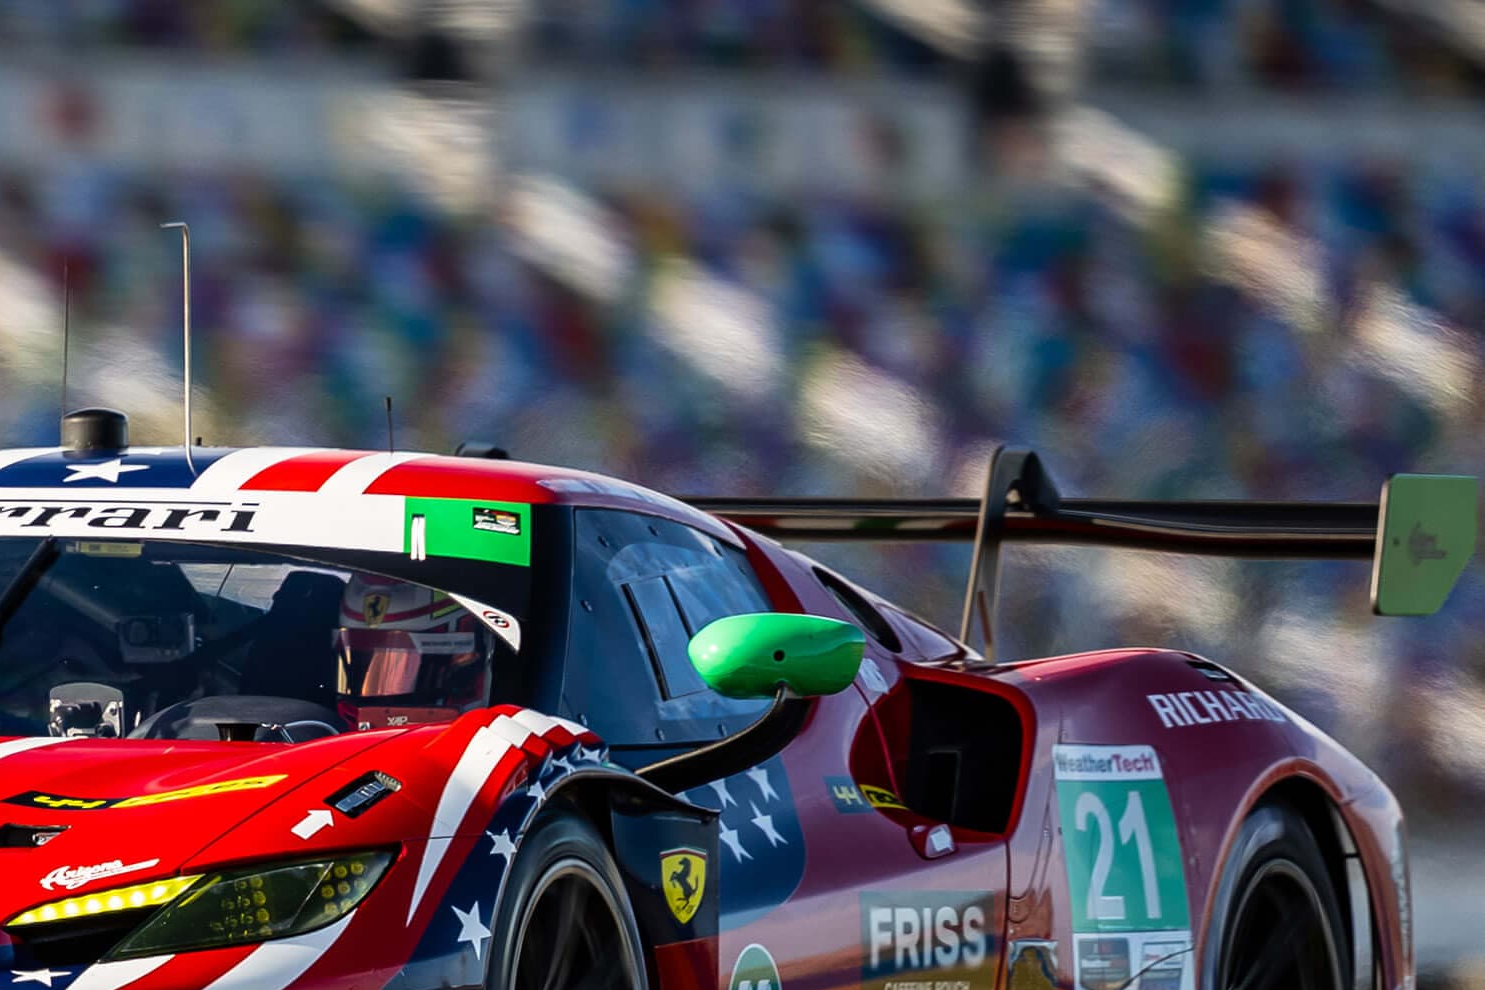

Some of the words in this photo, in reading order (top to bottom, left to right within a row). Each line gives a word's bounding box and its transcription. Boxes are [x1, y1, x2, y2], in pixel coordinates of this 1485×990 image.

[1056, 753, 1155, 774] WeatherTech
[1075, 791, 1161, 920] 21
[870, 906, 986, 968] FRISS
